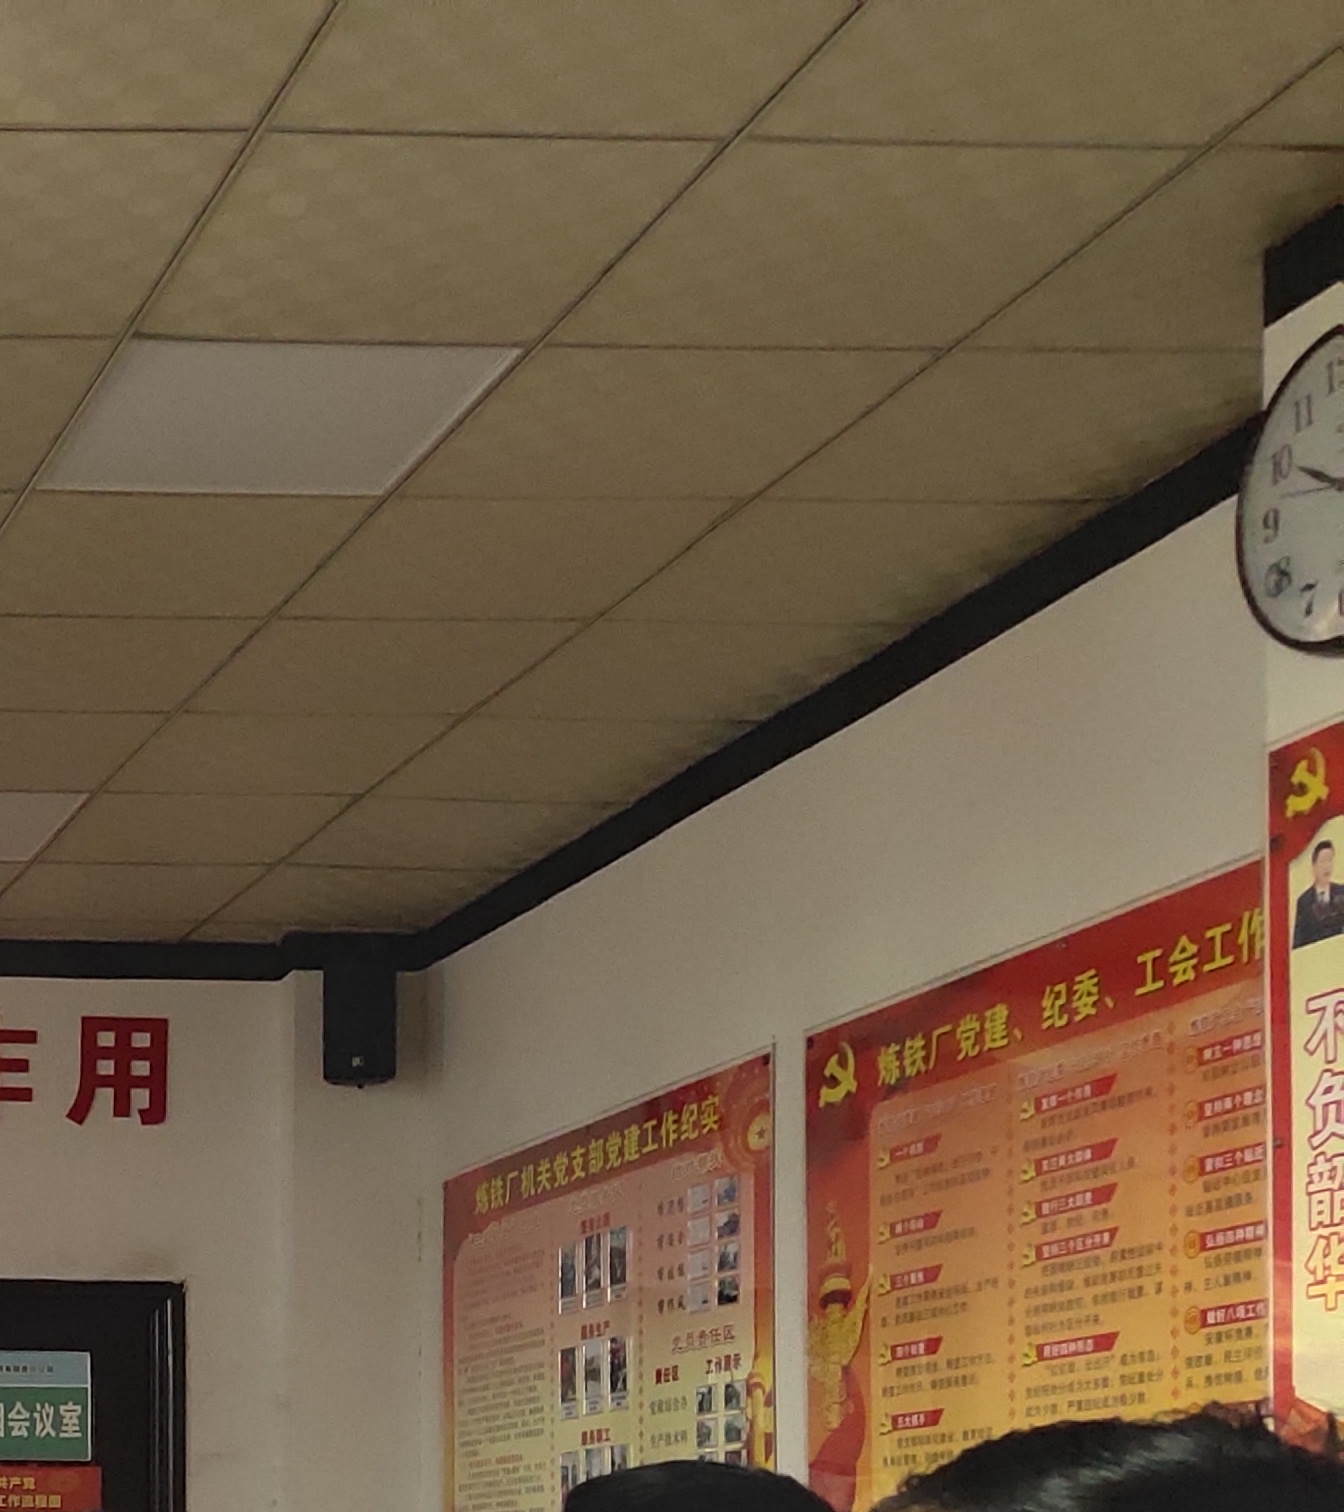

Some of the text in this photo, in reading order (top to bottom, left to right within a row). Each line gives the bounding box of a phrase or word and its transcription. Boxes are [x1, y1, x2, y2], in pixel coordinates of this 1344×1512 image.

[1295, 394, 1312, 432] 11
[1271, 444, 1292, 485] 10
[1263, 508, 1279, 543] 9
